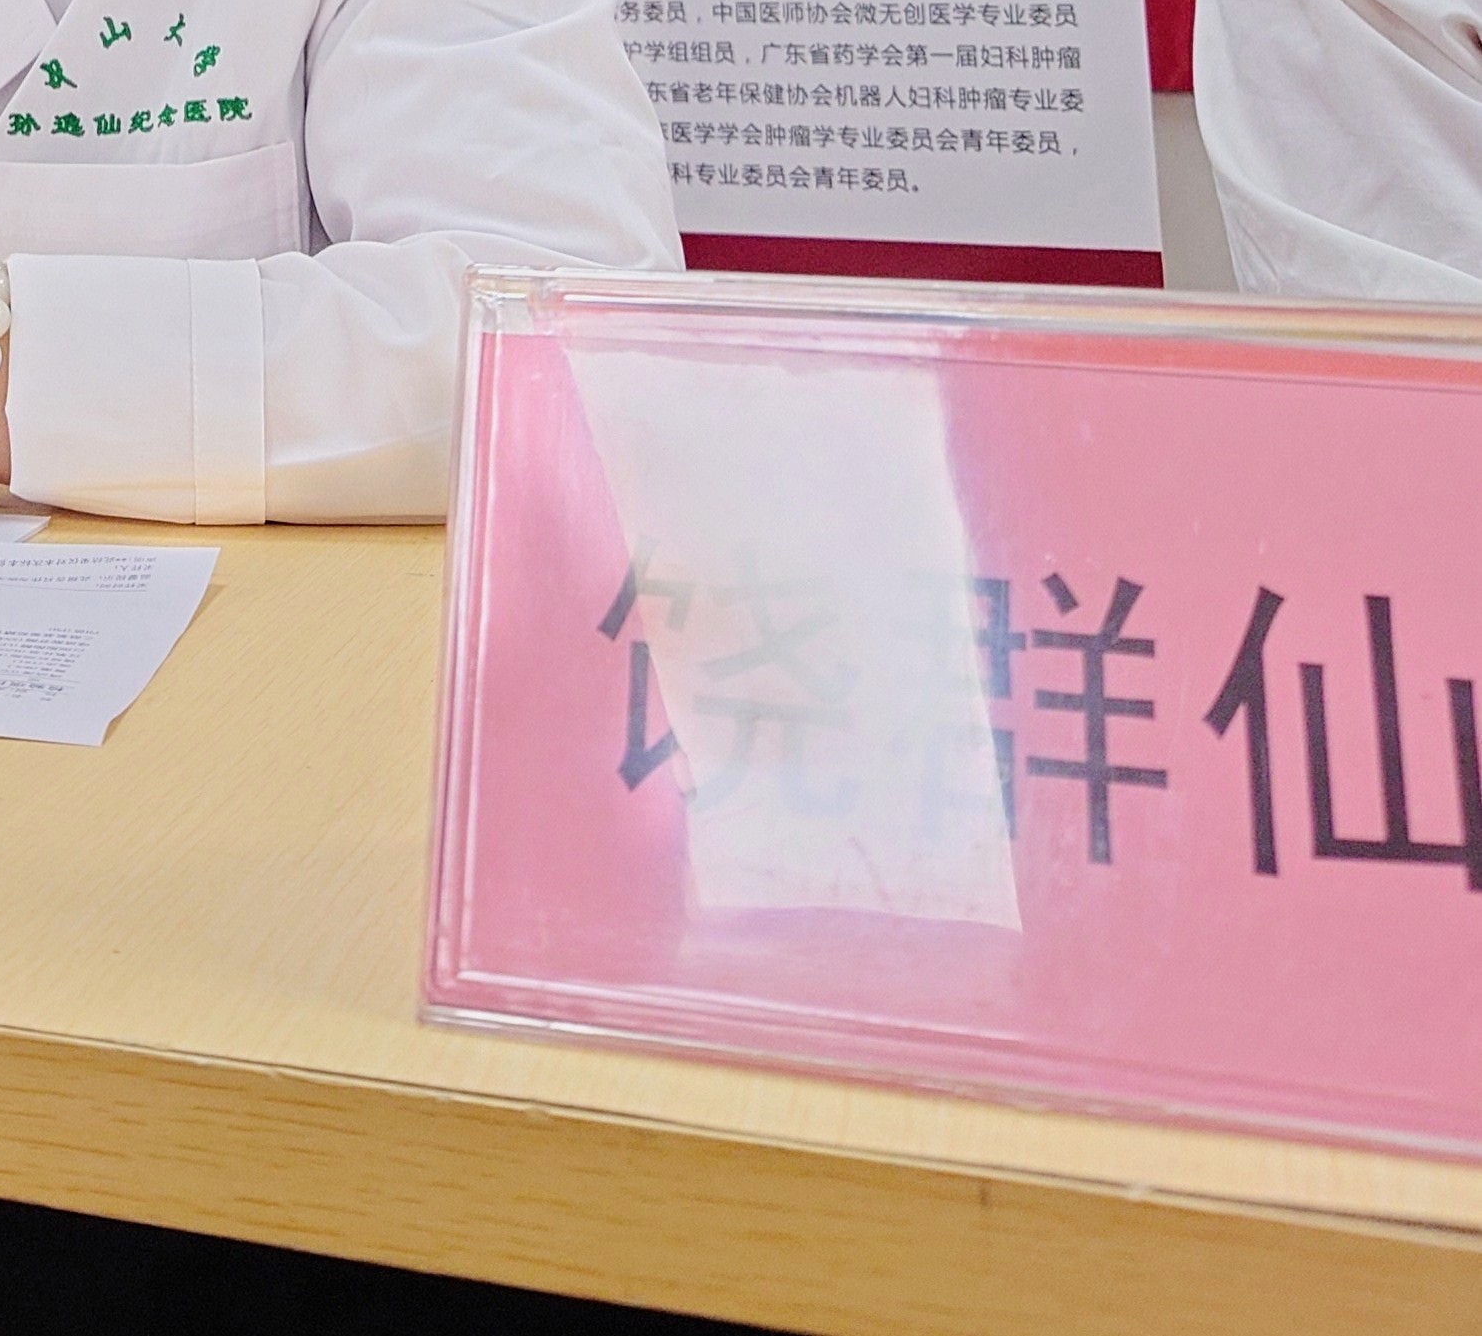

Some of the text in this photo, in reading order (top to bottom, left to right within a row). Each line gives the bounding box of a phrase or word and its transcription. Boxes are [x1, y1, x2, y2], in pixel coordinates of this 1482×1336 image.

[614, 0, 1079, 28] 务委员，中国医师协会微无创医学专业委员
[667, 161, 920, 194] 科专业委员会青年委员。
[596, 534, 1482, 893] 饶群仙
